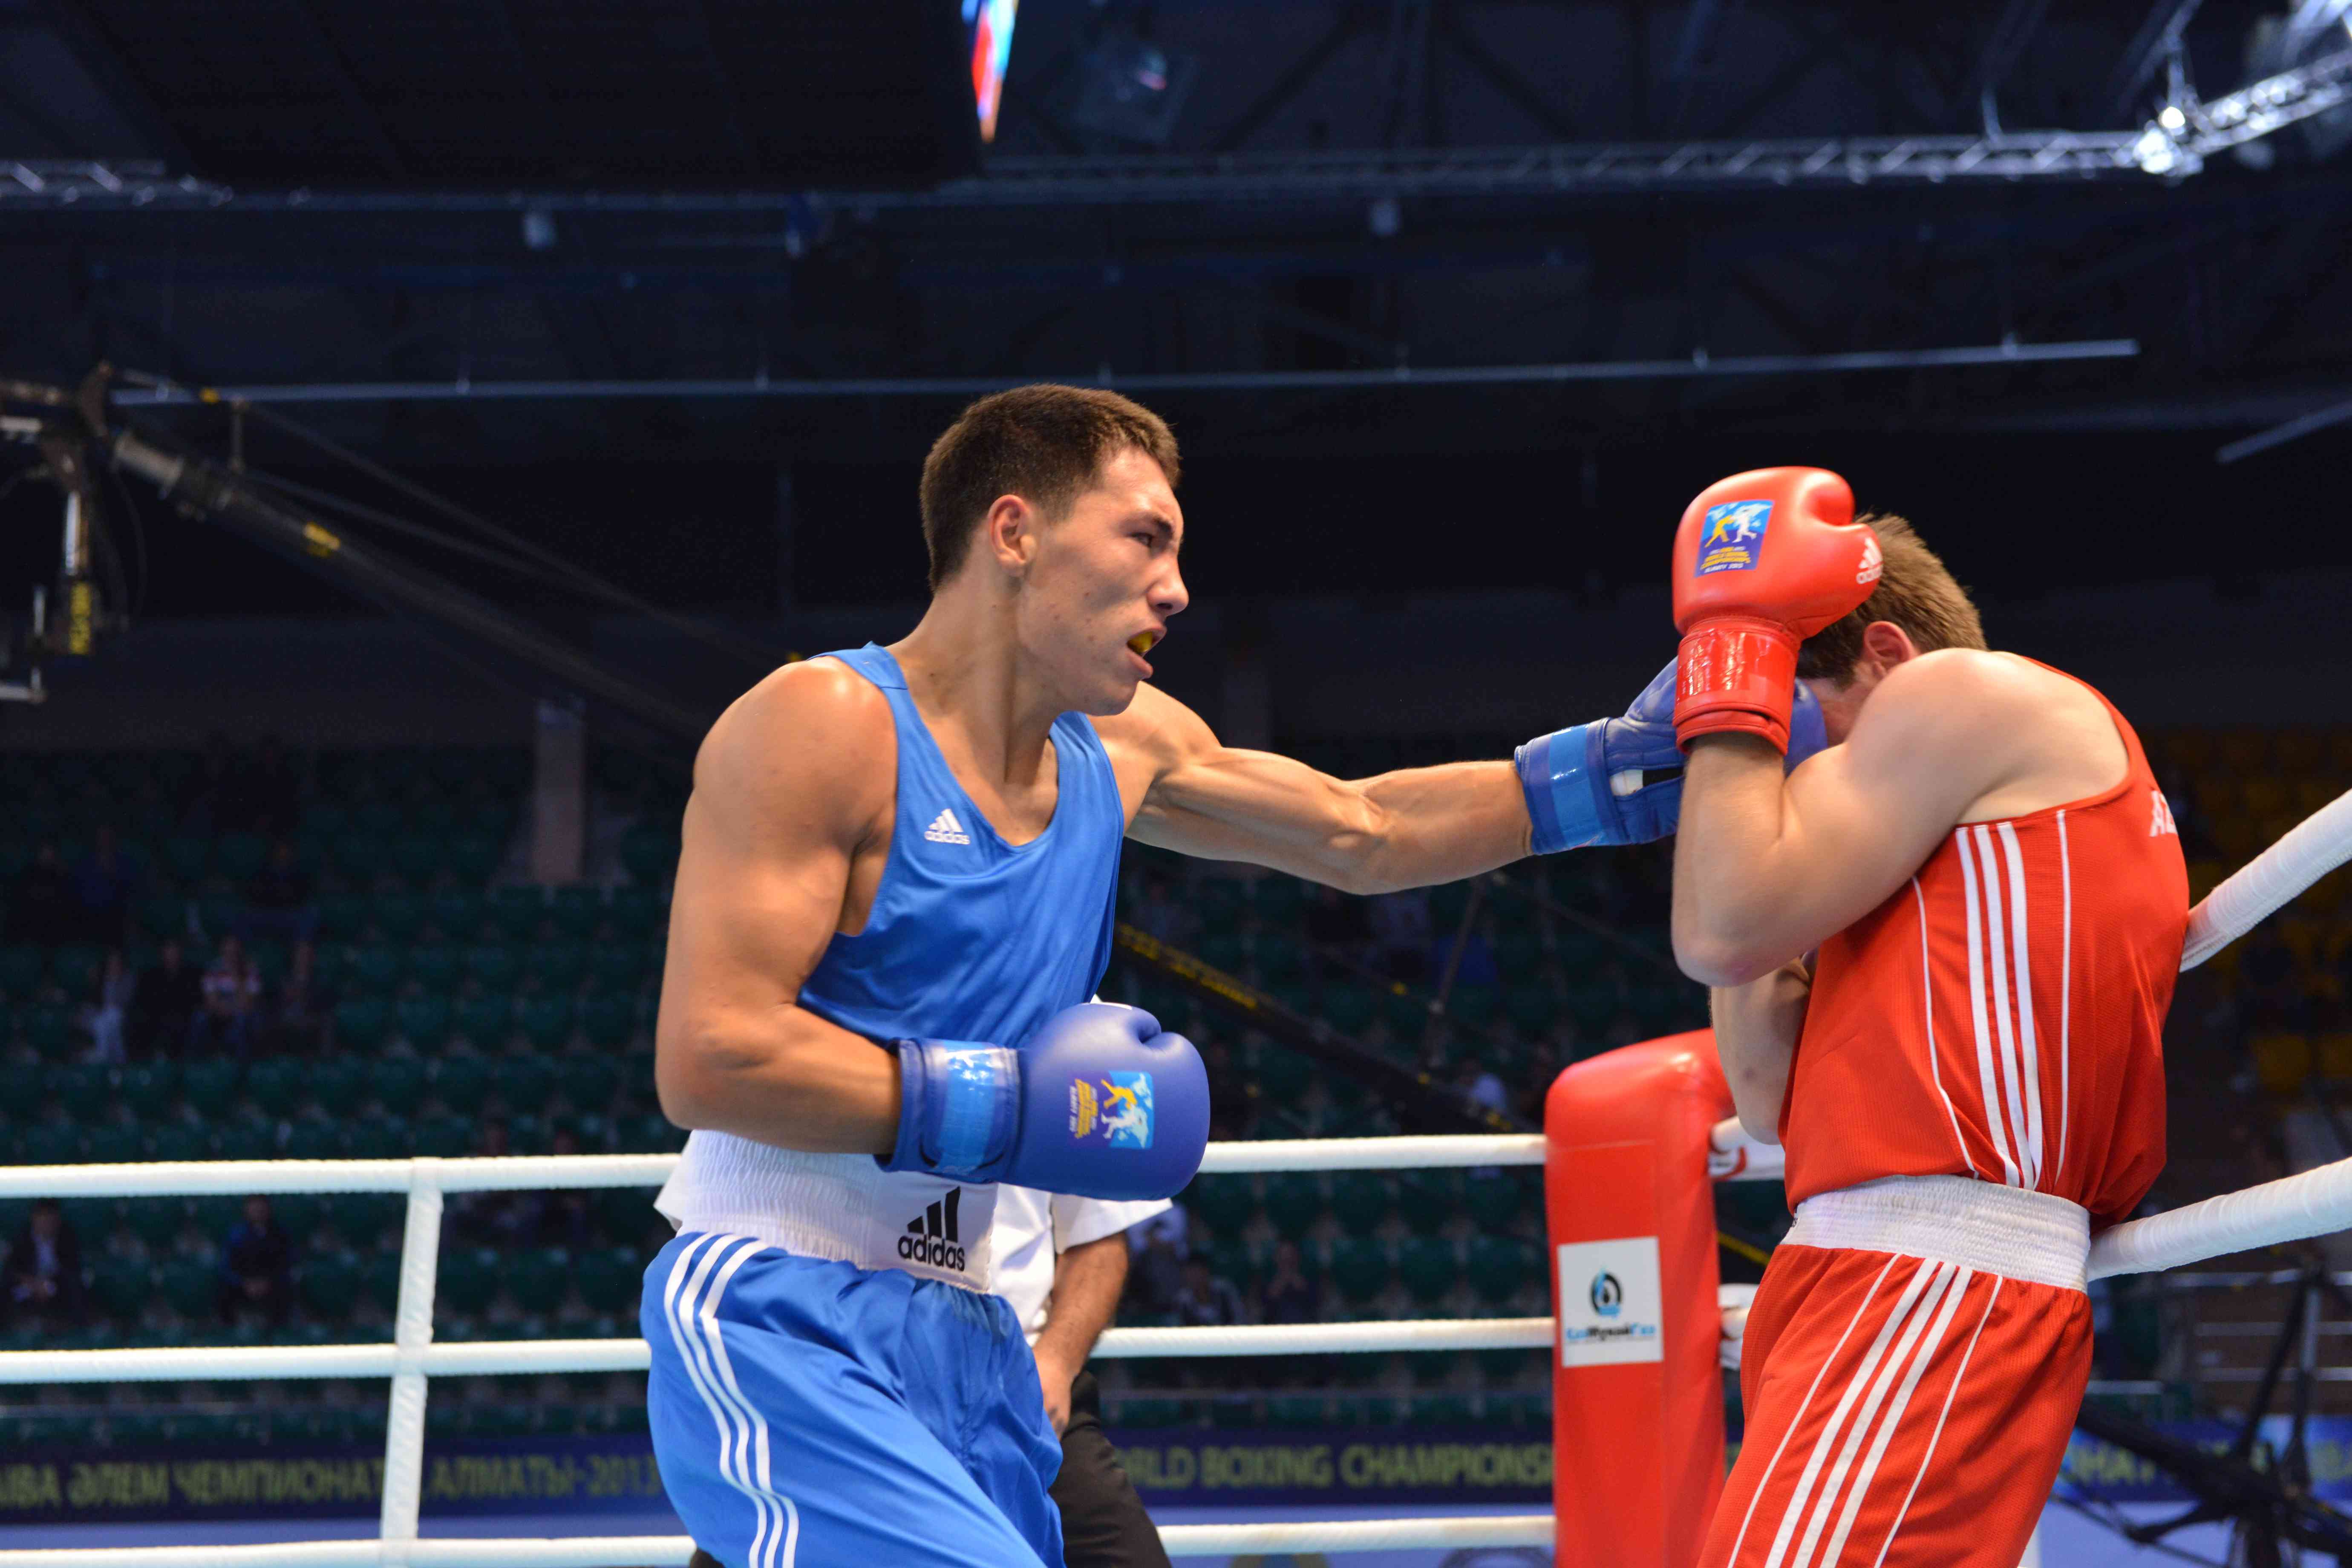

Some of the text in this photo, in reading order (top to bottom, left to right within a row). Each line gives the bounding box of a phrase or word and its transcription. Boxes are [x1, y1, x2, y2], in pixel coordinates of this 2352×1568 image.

[924, 830, 971, 845] adidas
[898, 1234, 965, 1272] adidas
[171, 1456, 386, 1505] ЧЕМПИОНАТ
[1200, 1445, 1335, 1489] BOXING
[1339, 1442, 1552, 1488] CHAMPIONS
